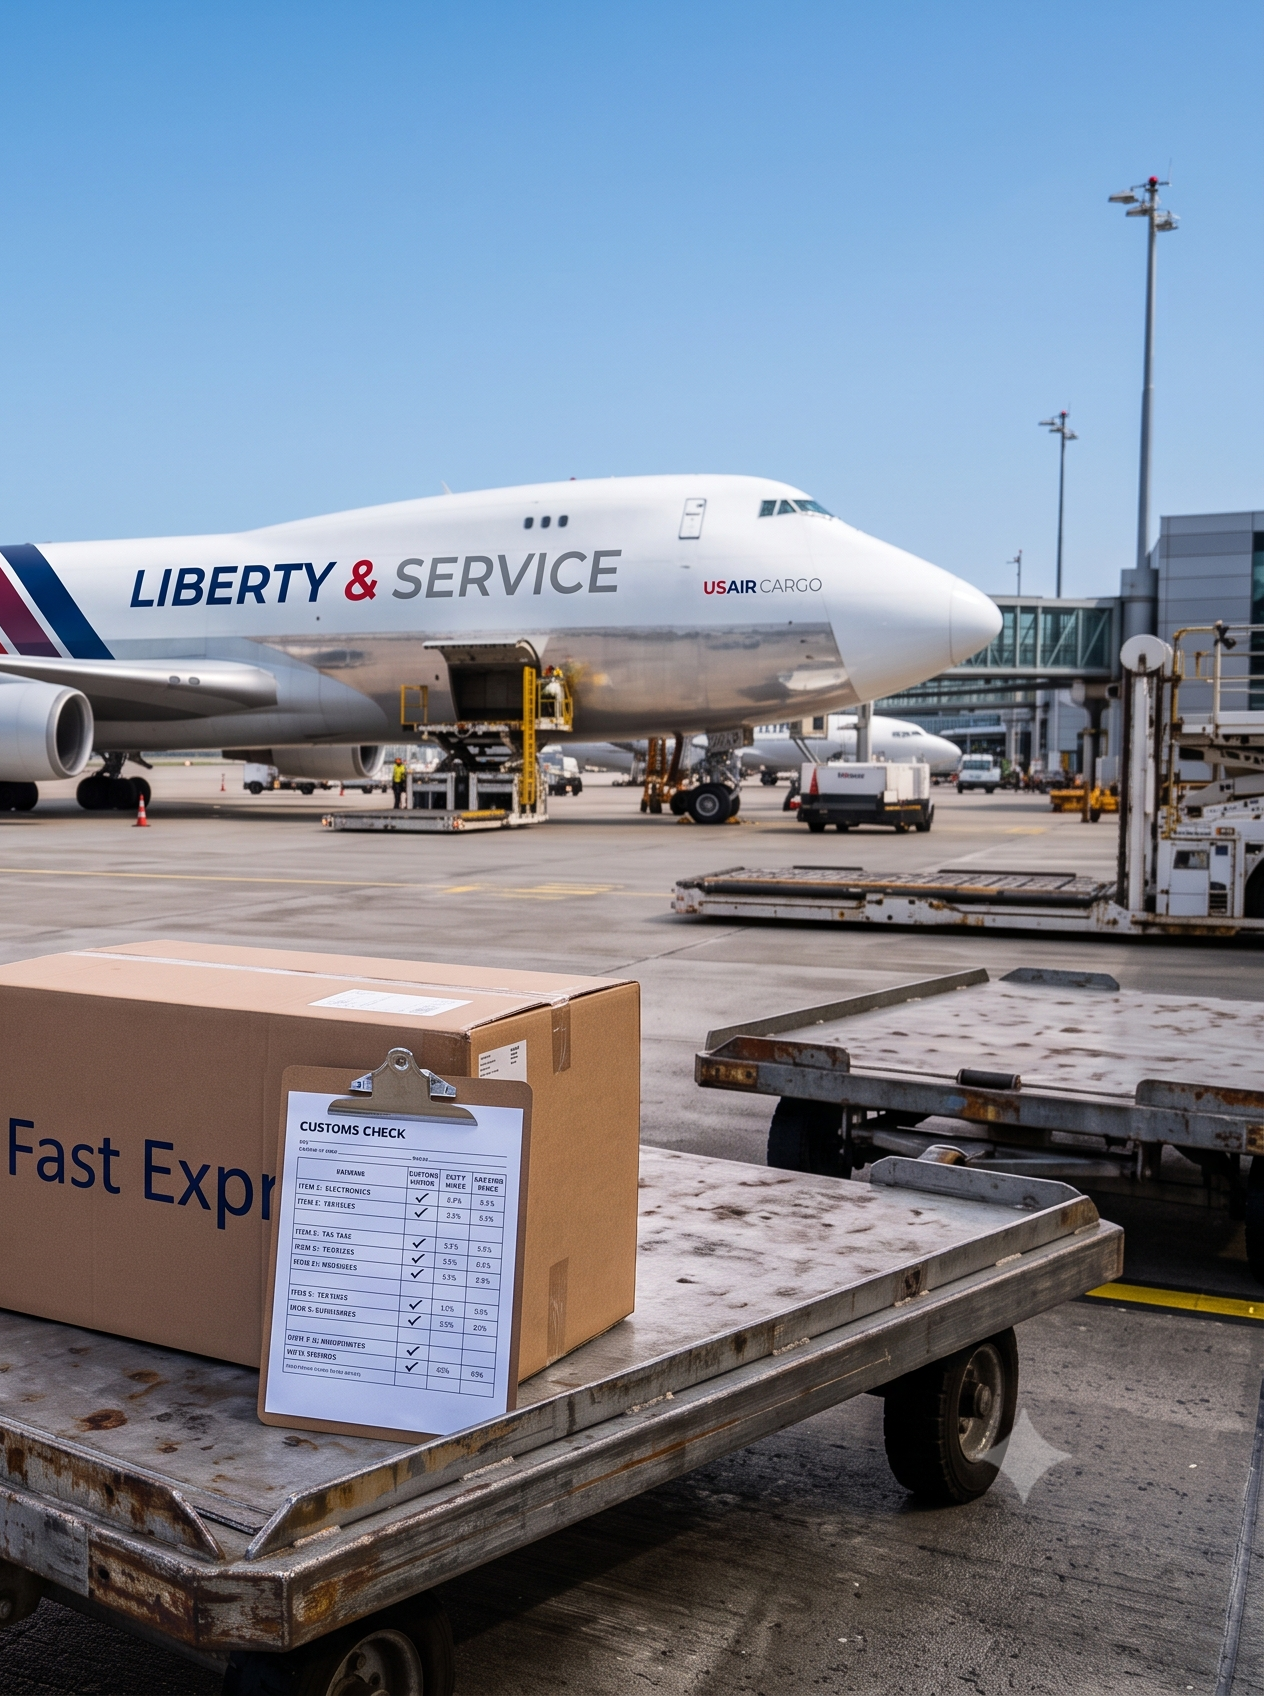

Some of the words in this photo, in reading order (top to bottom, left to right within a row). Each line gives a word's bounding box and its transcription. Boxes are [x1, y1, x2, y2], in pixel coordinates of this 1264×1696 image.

[129, 561, 337, 608] LIBERTY
[344, 559, 377, 602] &
[391, 549, 622, 600] SERVICE
[703, 580, 757, 595] USAIR
[759, 577, 822, 593] CARGO
[299, 1121, 360, 1136] CUSTOMS
[362, 1125, 406, 1140] CHECK
[8, 1117, 121, 1195] Fast
[325, 1185, 371, 1196] ELECTRONICS
